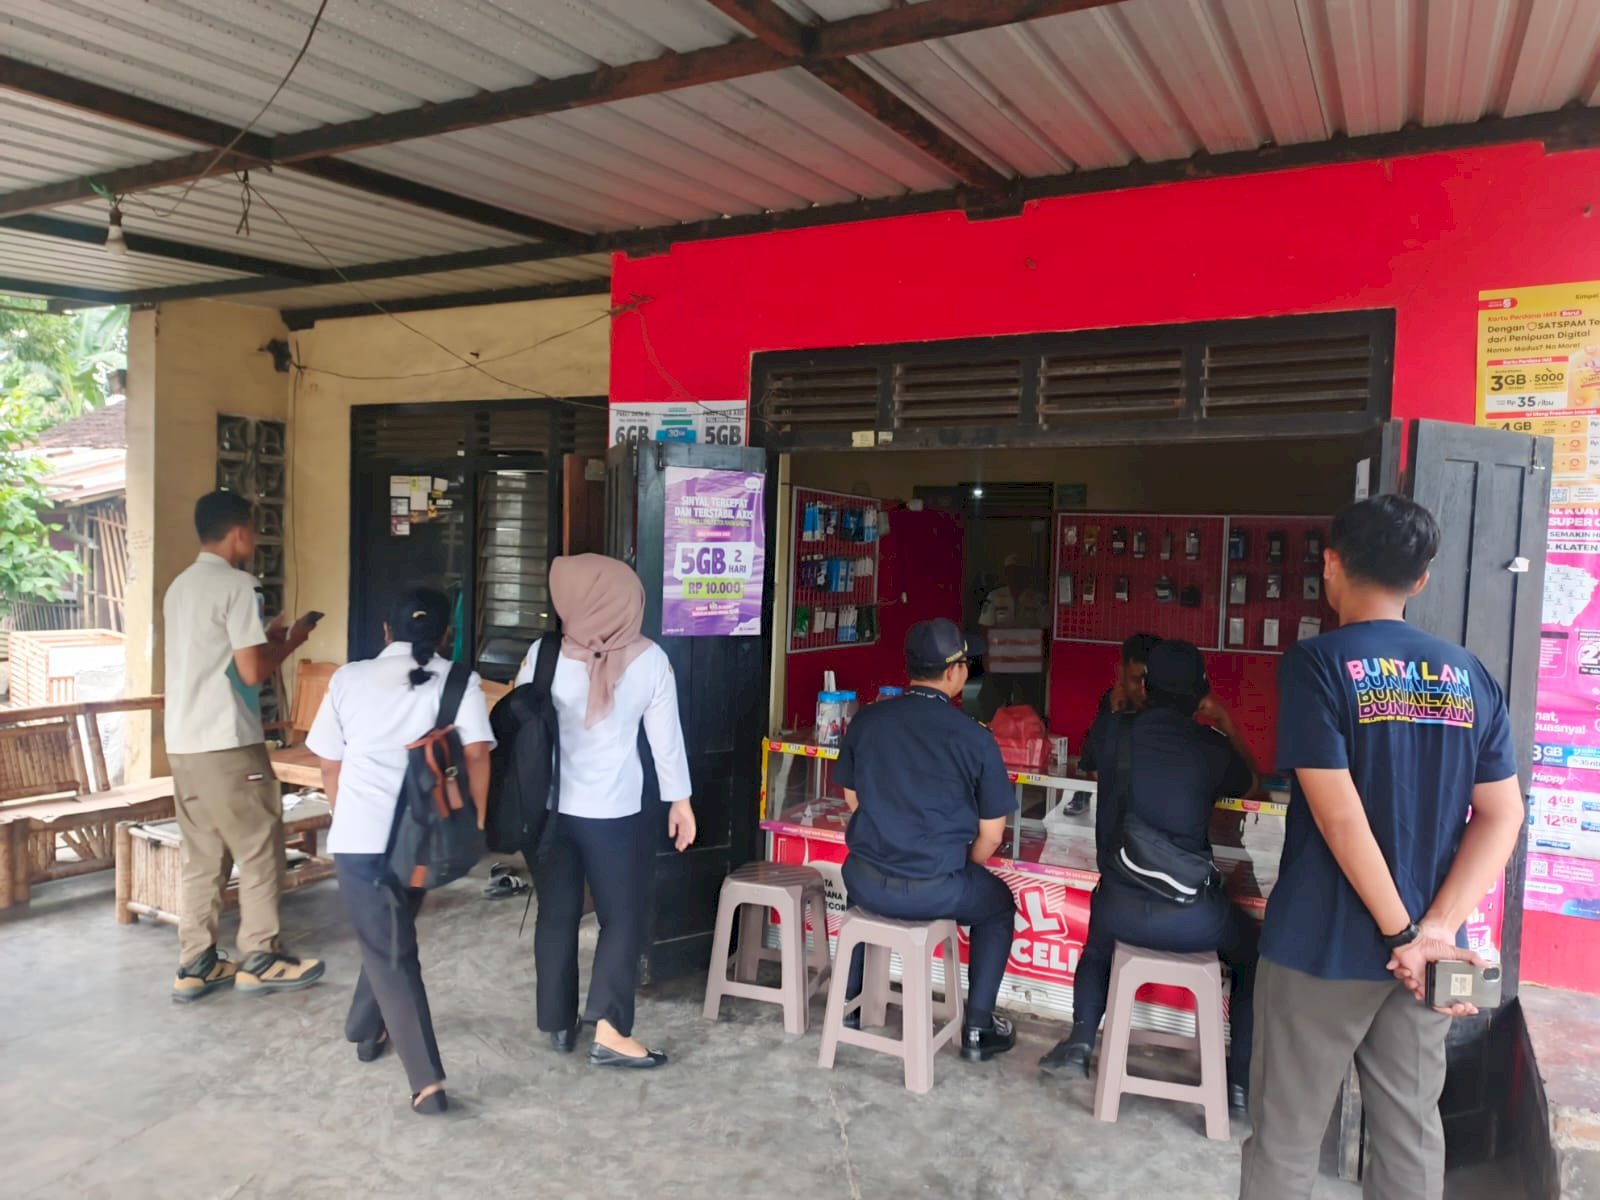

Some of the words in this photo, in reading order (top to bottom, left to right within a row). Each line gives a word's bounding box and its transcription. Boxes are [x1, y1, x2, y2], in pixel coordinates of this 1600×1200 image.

[1487, 323, 1525, 334] Dengan
[1537, 319, 1586, 330] SATSPAM
[1487, 335, 1507, 344] dari
[1509, 332, 1555, 344] Penipuan
[1557, 329, 1590, 341] Digital
[1534, 373, 1564, 382] 5000
[1517, 396, 1536, 407] 35
[705, 425, 742, 446] 5GB
[1549, 518, 1592, 526] SUPER
[681, 546, 727, 576] 5GB
[734, 549, 743, 563] 2
[728, 564, 747, 574] HARI
[688, 582, 703, 595] RP
[705, 581, 741, 595] 10.000
[1347, 658, 1470, 685] BUNTALAN
[1531, 771, 1567, 786] Happy
